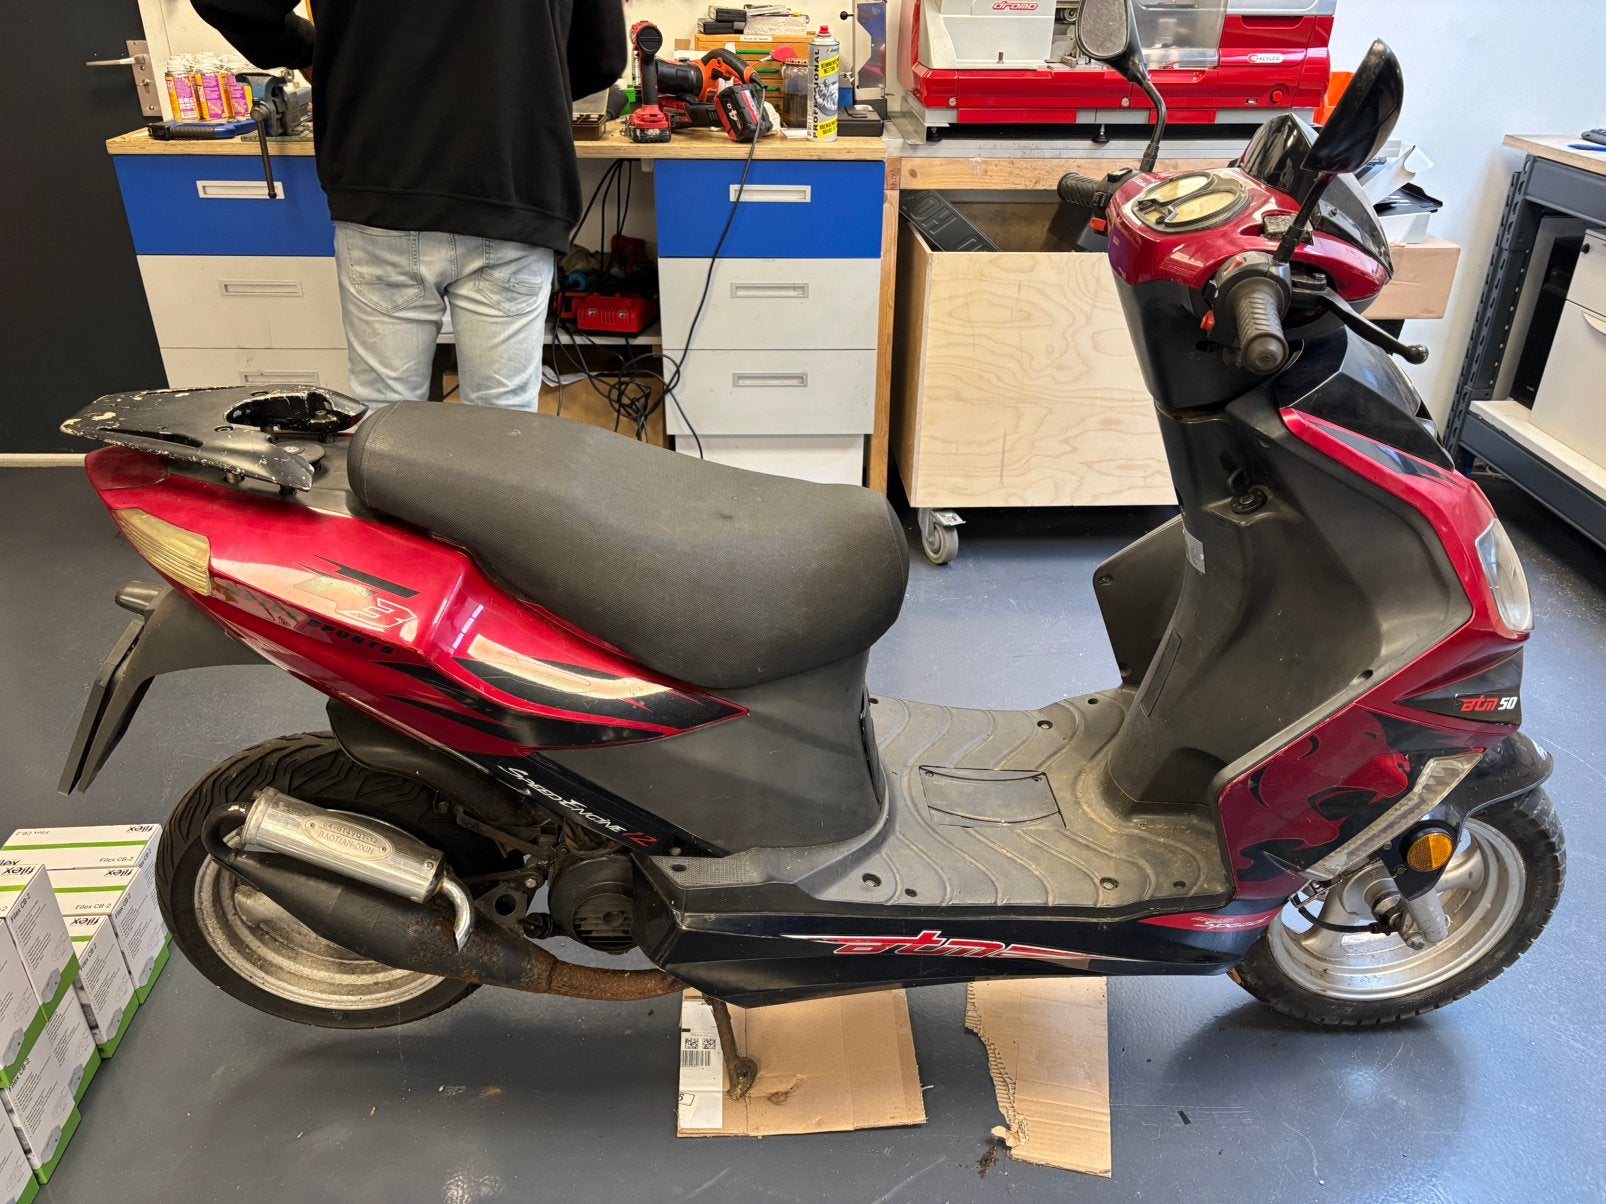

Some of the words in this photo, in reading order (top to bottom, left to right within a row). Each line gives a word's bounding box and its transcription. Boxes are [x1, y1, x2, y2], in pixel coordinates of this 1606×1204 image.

[992, 1, 1039, 10] dromo
[306, 619, 396, 654] SPORTS
[1498, 696, 1518, 710] 50
